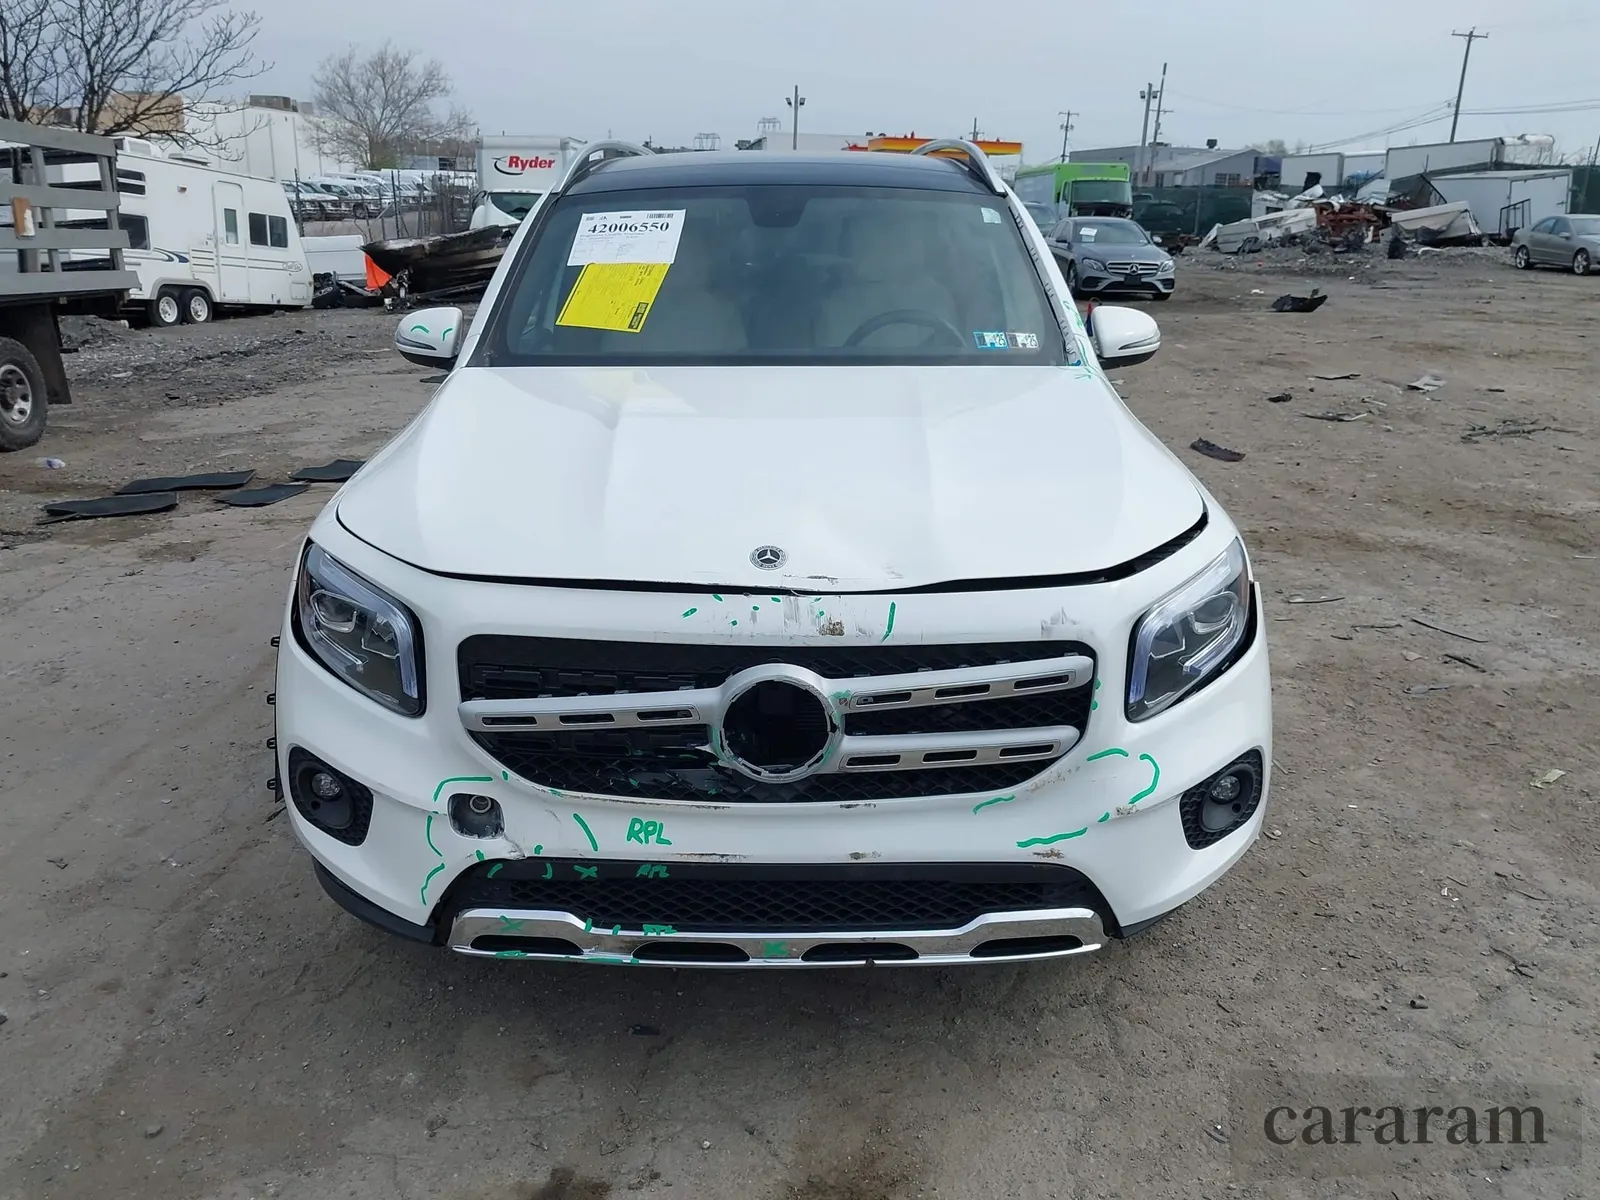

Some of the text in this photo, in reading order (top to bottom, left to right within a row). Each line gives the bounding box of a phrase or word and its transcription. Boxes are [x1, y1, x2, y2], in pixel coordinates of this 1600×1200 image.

[508, 156, 555, 171] Ryder
[588, 221, 670, 233] 42006550
[626, 817, 672, 845] RPL
[635, 863, 670, 878] RPL
